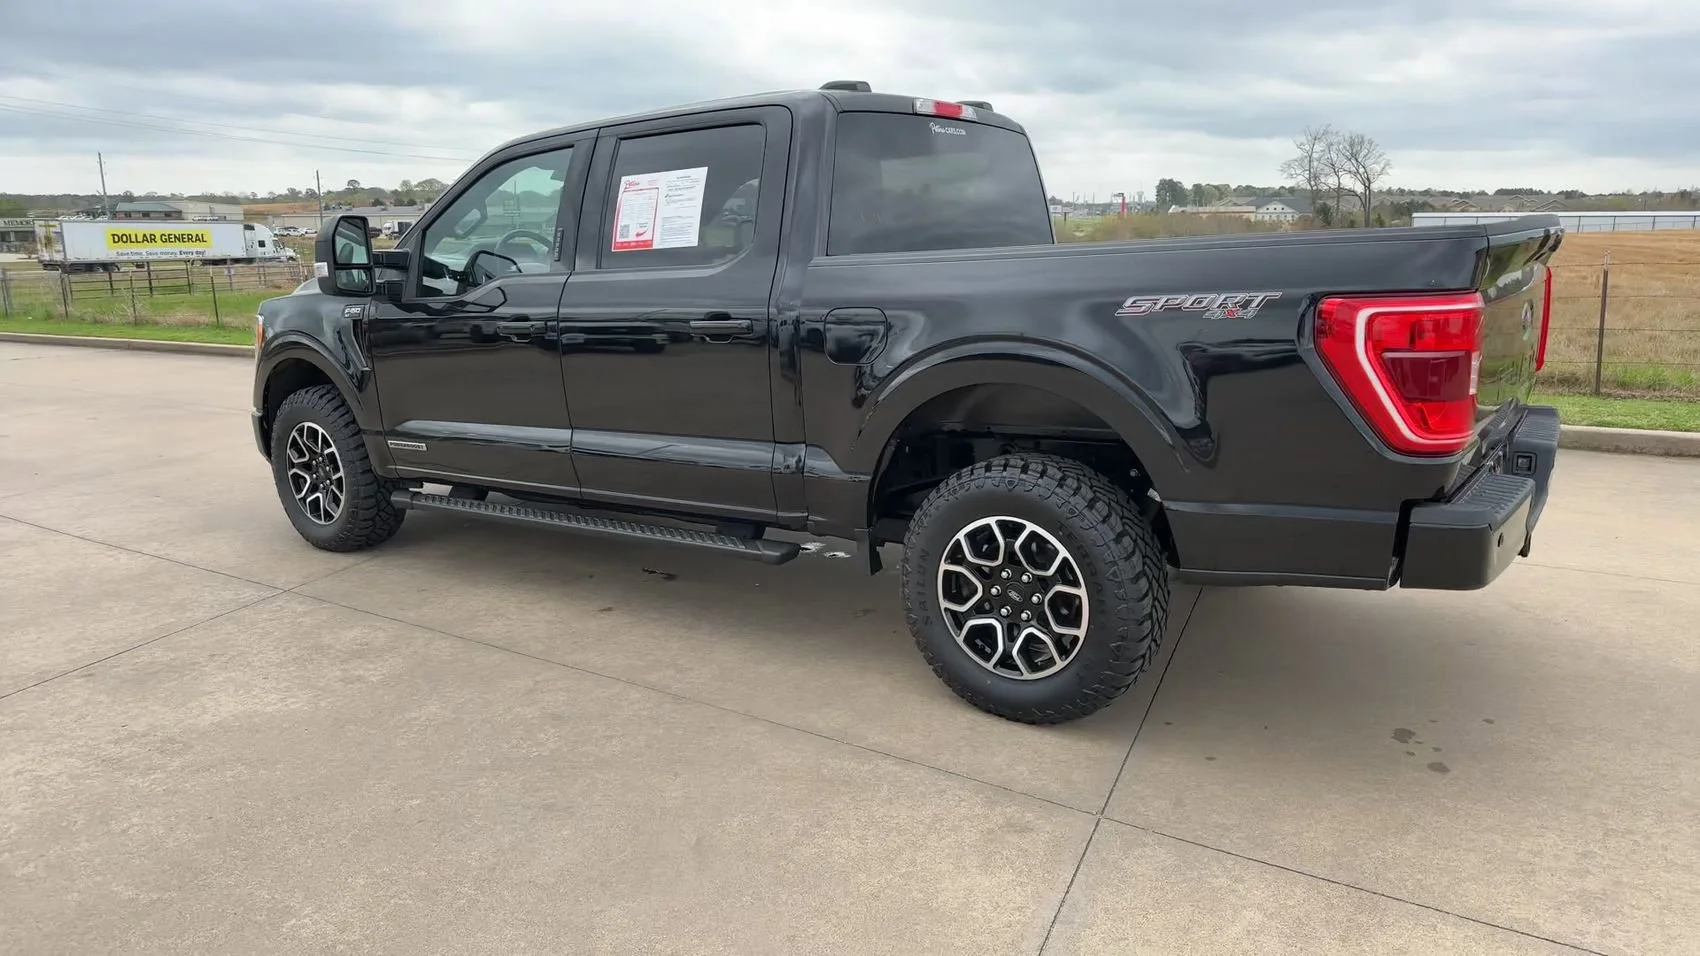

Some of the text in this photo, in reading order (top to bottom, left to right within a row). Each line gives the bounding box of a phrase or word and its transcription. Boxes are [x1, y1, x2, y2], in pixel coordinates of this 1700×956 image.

[111, 233, 208, 244] DOLLAR GENERAL
[179, 249, 195, 257] Every
[195, 249, 207, 257] day!
[1115, 291, 1282, 316] SPORT
